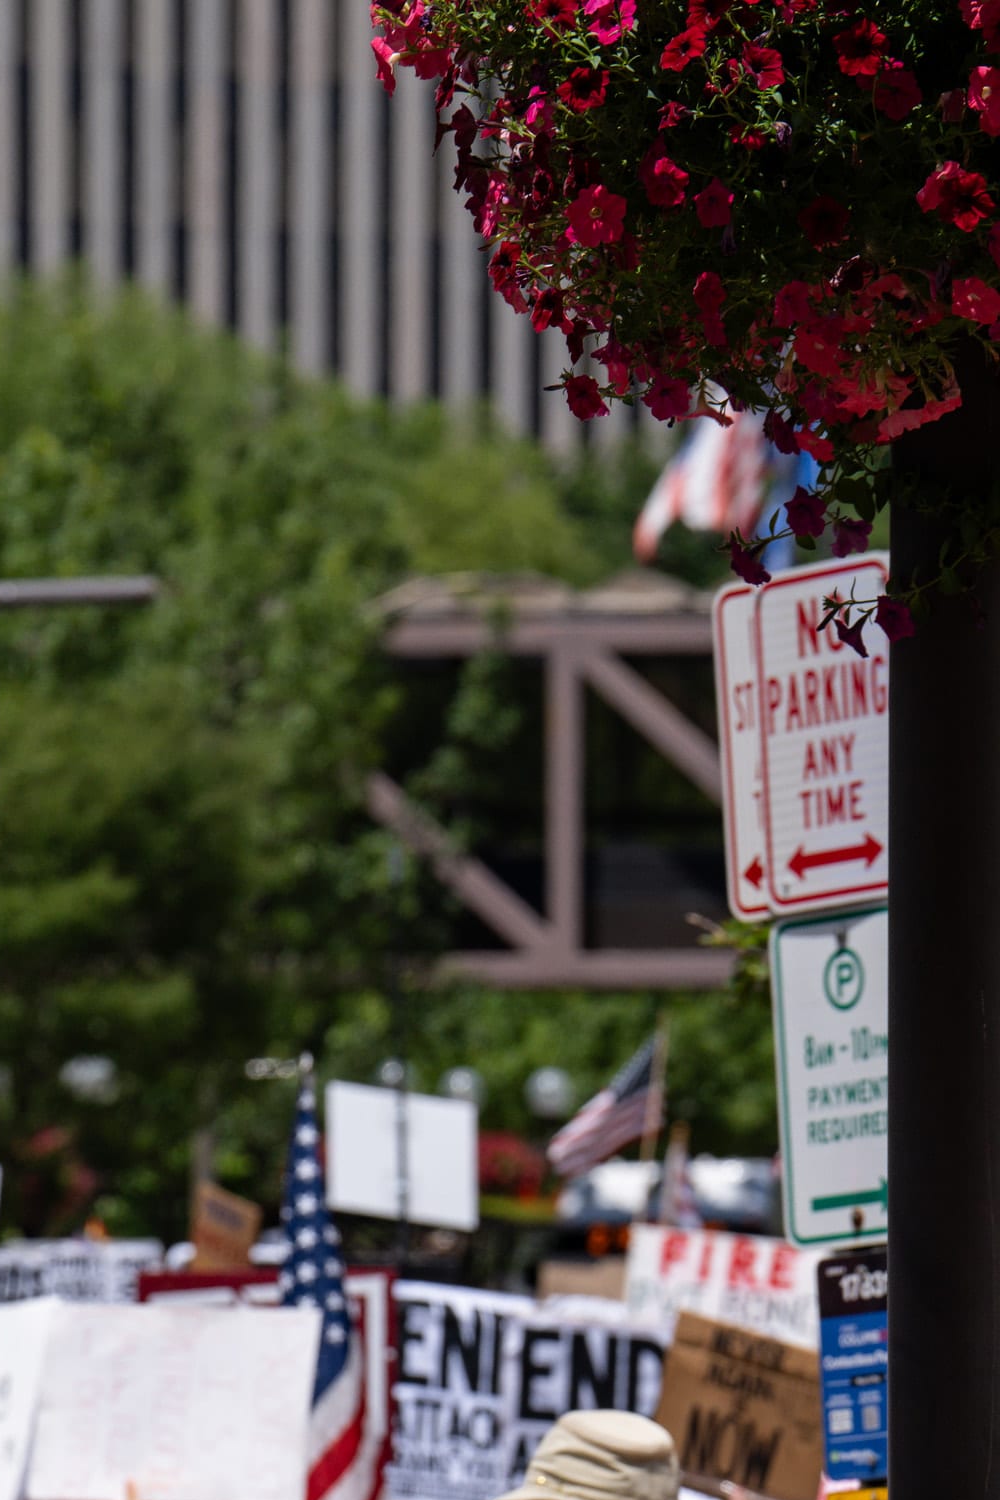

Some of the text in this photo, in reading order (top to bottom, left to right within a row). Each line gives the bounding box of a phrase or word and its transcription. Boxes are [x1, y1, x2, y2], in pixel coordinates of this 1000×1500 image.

[797, 592, 851, 658] NO
[767, 657, 887, 735] PARKING
[803, 734, 856, 781] ANY
[800, 782, 867, 830] TIME
[660, 1228, 800, 1291] FIRE
[518, 1328, 667, 1420] END
[681, 1402, 783, 1489] NOW
